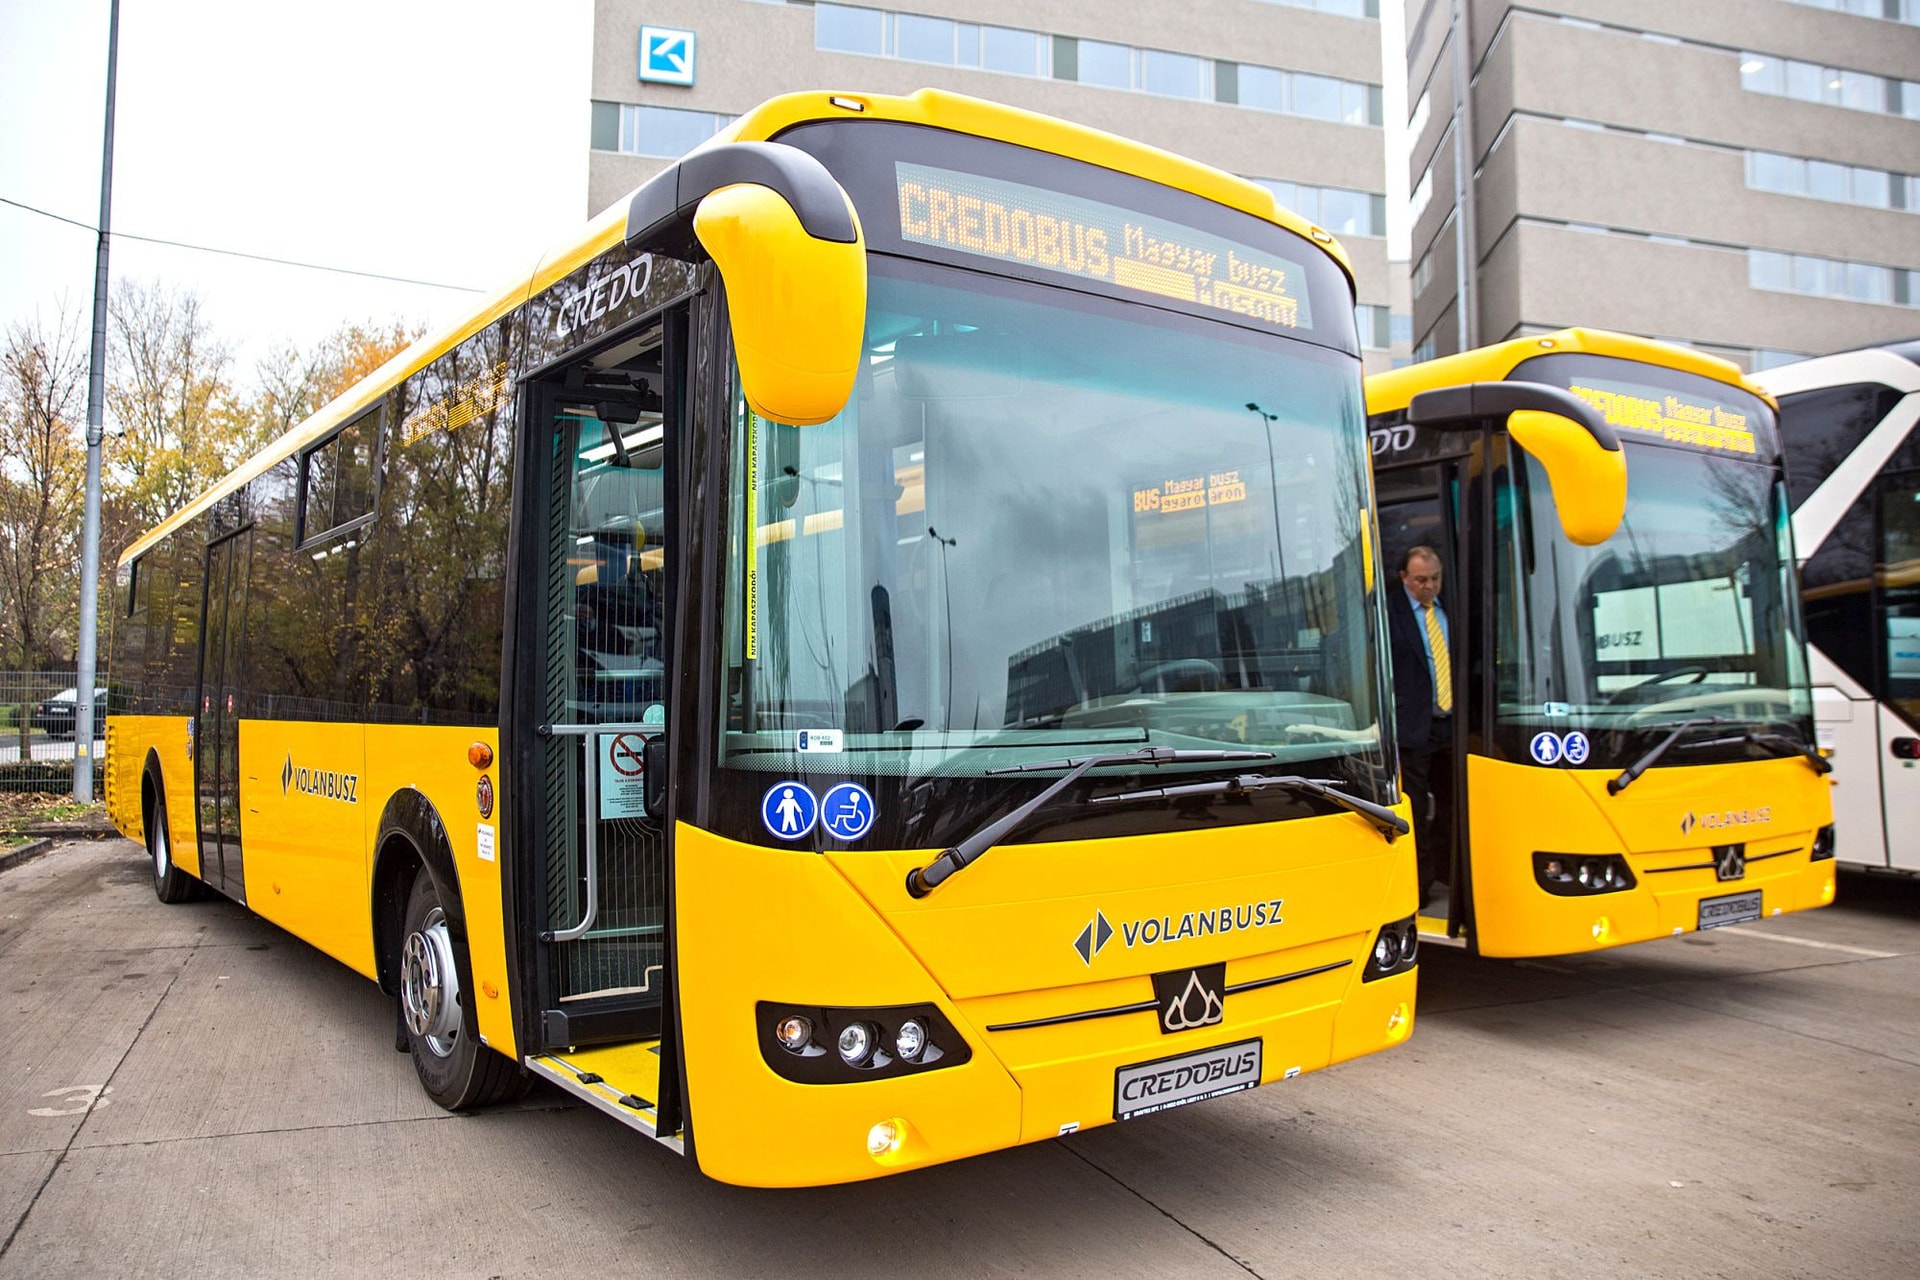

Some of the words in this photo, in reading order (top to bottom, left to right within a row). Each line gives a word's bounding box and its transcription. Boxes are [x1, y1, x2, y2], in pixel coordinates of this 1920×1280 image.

[901, 181, 1109, 277] CREDOBUS
[1123, 223, 1217, 276] Magyar
[1228, 250, 1287, 294] busz
[557, 253, 653, 338] CREDO
[1134, 487, 1161, 512] BUS
[1122, 900, 1283, 947] VOLÁNBUSZ
[1122, 1051, 1257, 1101] CREDOBUS
